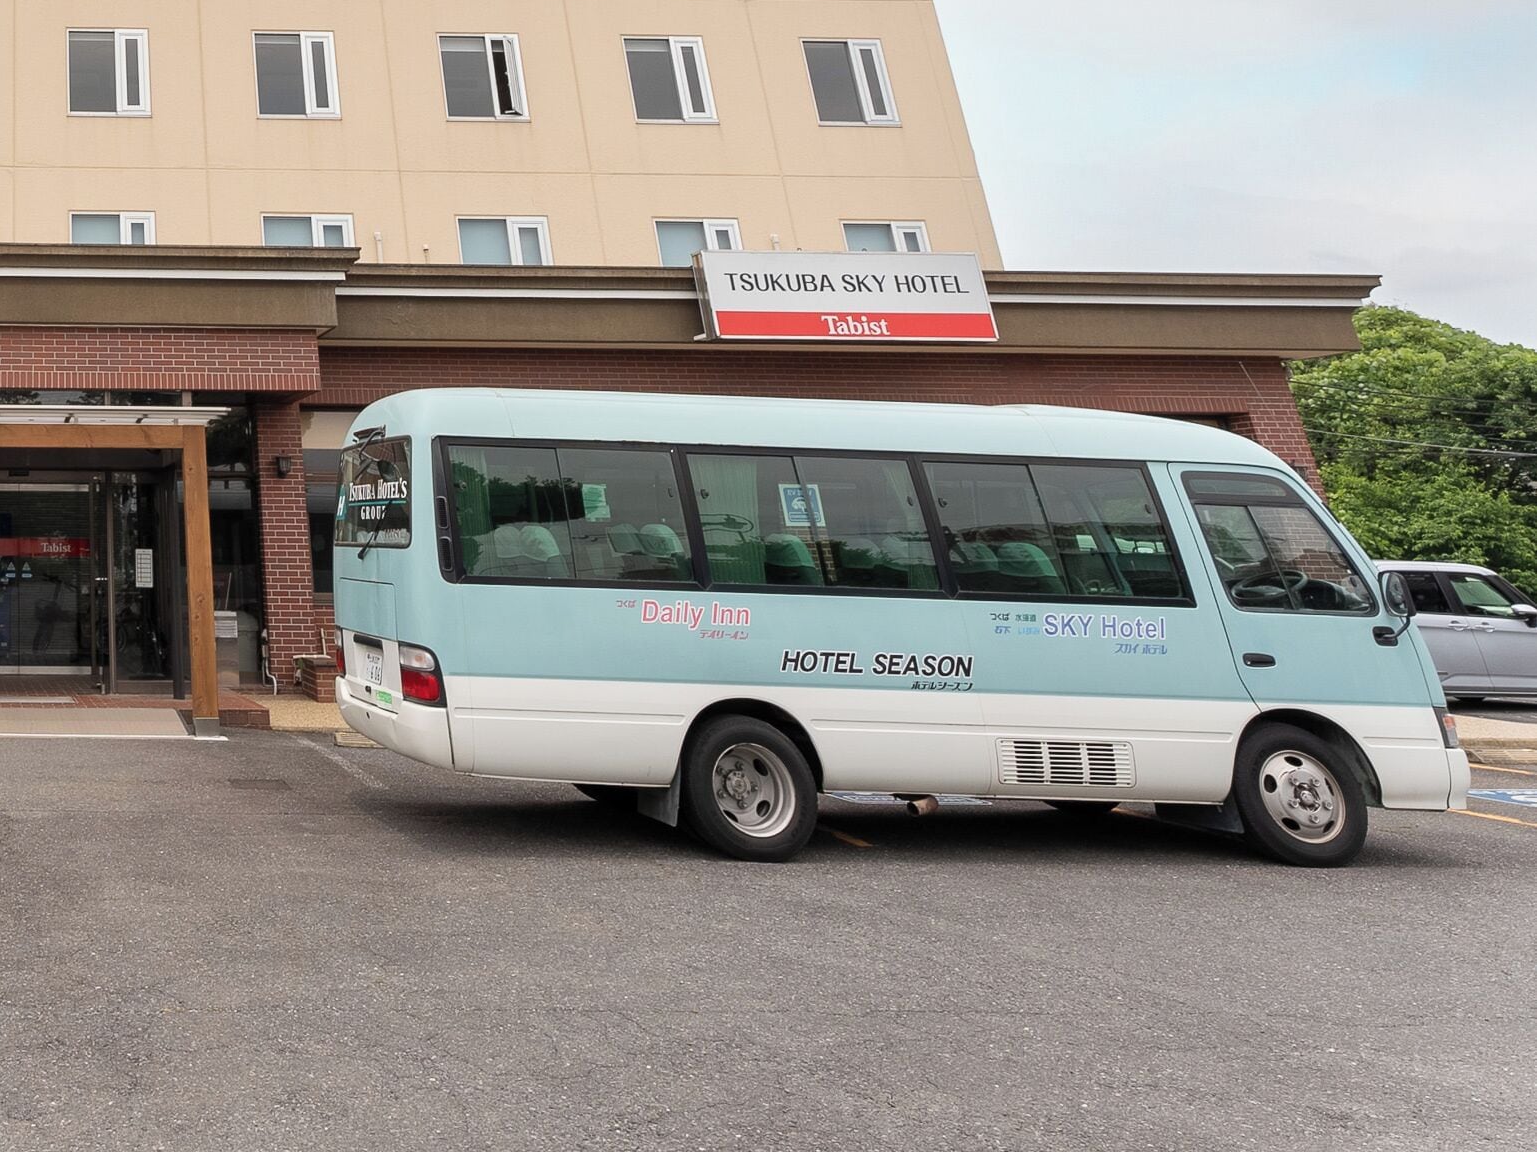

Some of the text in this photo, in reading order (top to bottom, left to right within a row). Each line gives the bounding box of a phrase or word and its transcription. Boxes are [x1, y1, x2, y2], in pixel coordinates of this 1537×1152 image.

[724, 272, 970, 294] TSUKUBA SKY HOTEL
[821, 314, 890, 336] Tabist
[41, 542, 72, 553] Tabist
[616, 599, 637, 609] つくば
[641, 599, 751, 630] Daily Inn
[989, 612, 1010, 622] つくば
[1042, 613, 1167, 640] SKY Hotel
[781, 649, 975, 678] HOTEL SEASON
